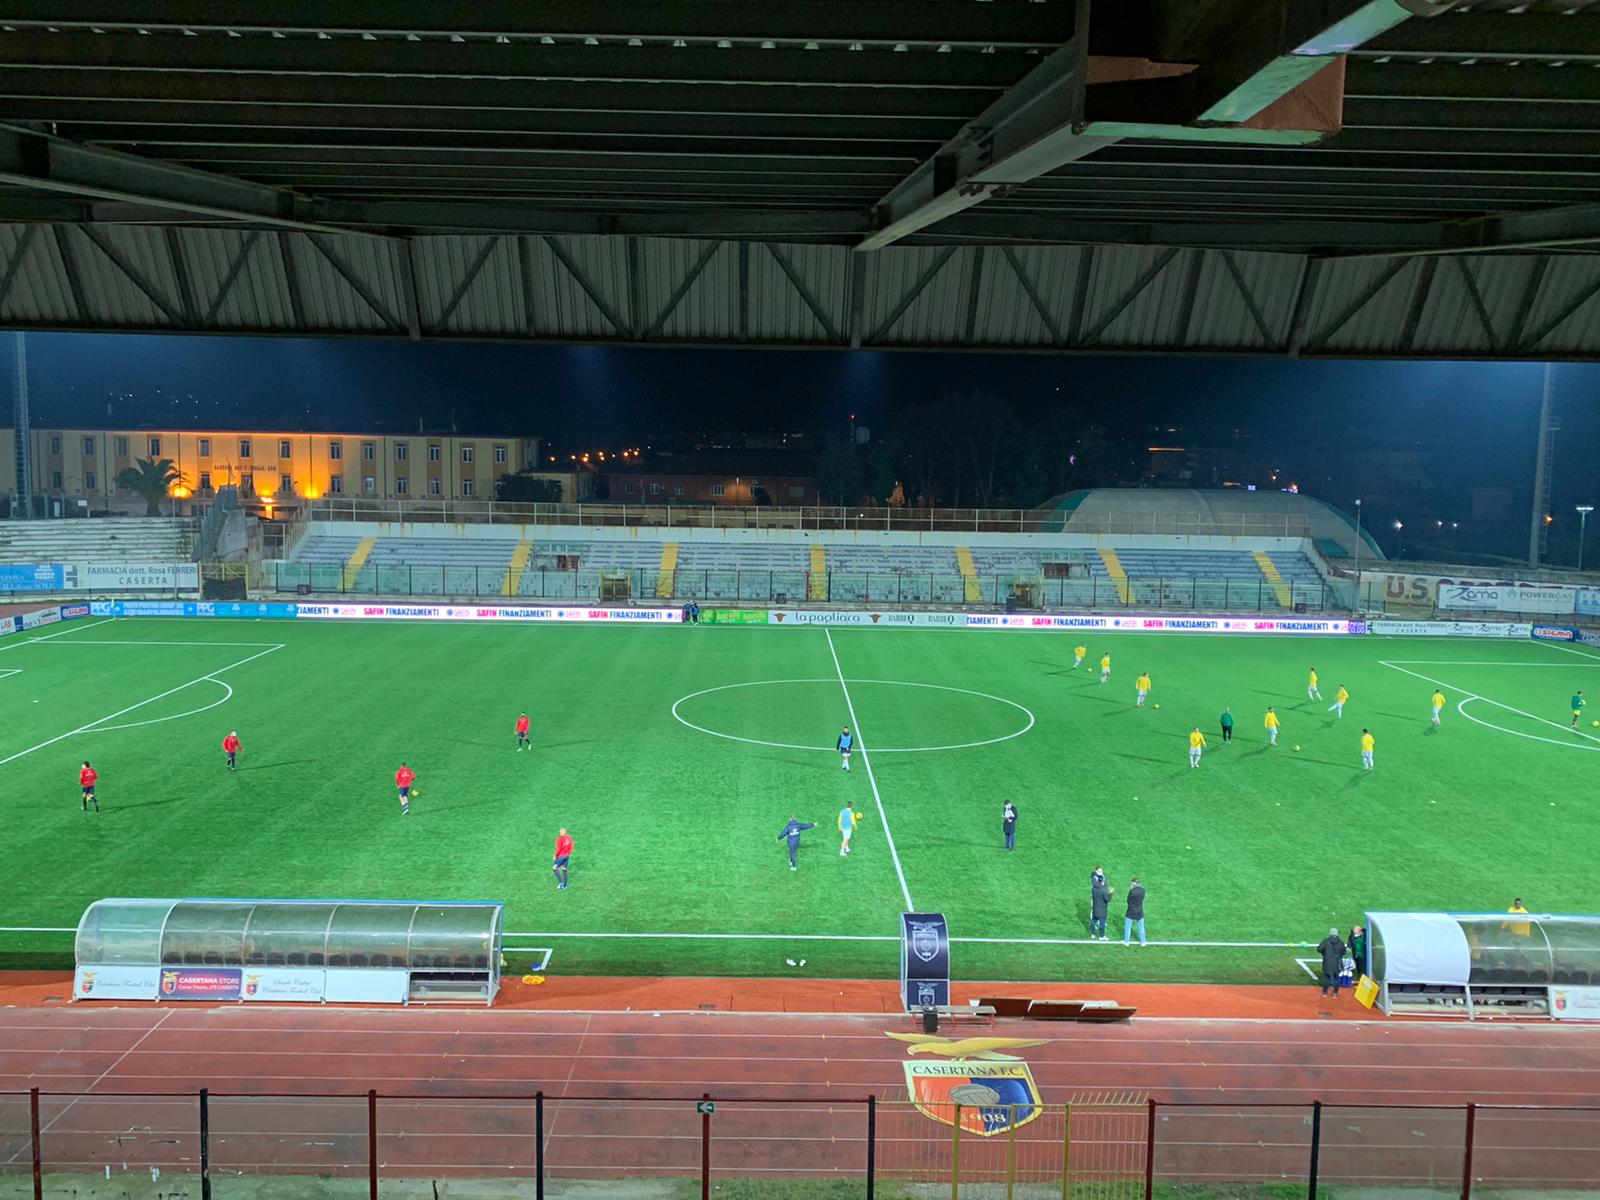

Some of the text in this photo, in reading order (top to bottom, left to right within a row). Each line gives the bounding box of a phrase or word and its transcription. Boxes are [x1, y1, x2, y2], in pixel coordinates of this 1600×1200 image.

[1519, 591, 1573, 600] POWERGAS
[386, 608, 439, 616] FINANZIAMENTI
[796, 612, 806, 621] la
[1054, 618, 1106, 626] FINANZIAMENTI
[1165, 620, 1218, 628] FINANZIAMENTI
[1276, 622, 1328, 630] FINANZIAMENTI
[913, 1066, 1023, 1076] CASERTANA F.C.
[960, 1113, 1006, 1123] 1908
